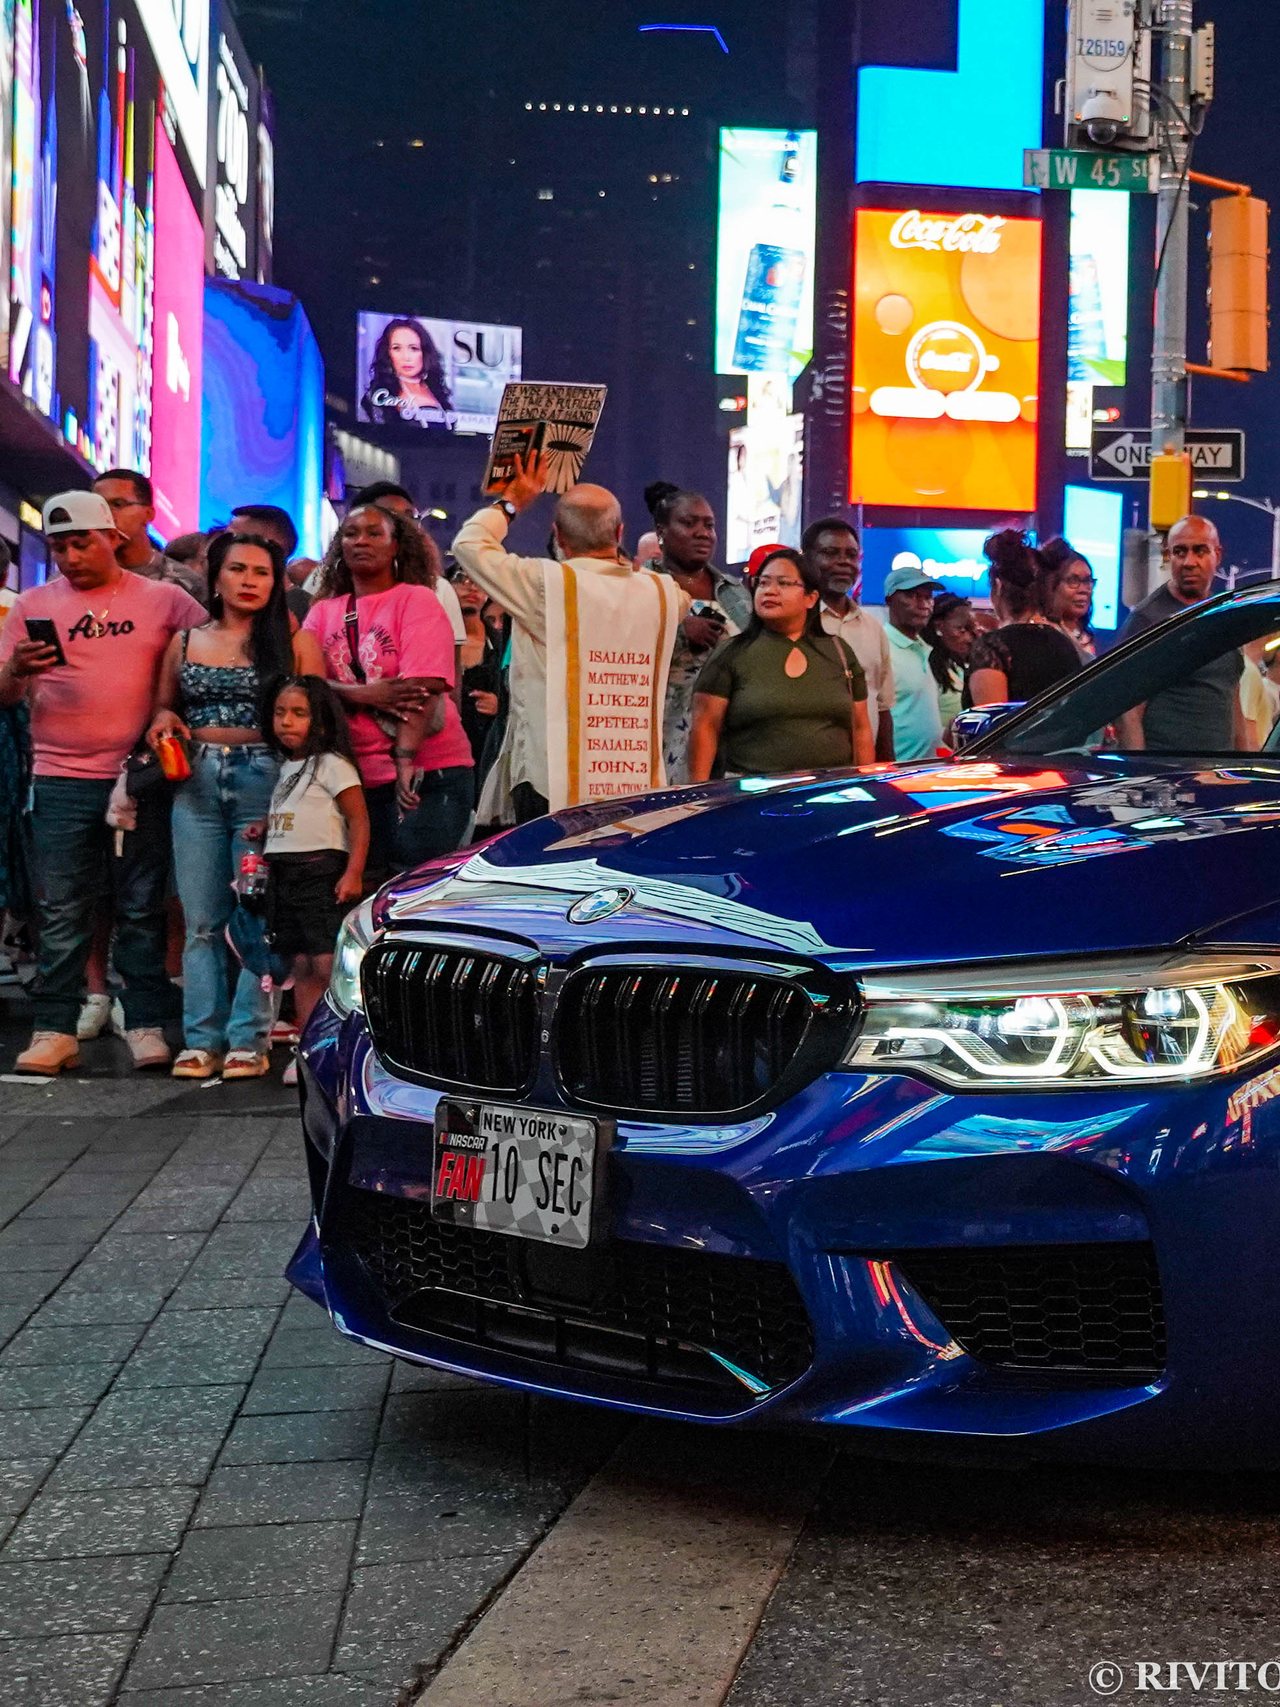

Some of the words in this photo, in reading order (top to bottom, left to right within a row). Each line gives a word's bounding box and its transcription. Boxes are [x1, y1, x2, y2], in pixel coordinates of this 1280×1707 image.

[1055, 157, 1078, 184] W
[1091, 159, 1121, 187] 45
[890, 210, 1006, 253] Coca-Cola
[454, 330, 504, 367] SU
[501, 408, 517, 420] THE
[504, 397, 520, 408] THE
[68, 614, 135, 642] Aero
[589, 650, 650, 665] ISAIAH.24
[588, 671, 650, 687] MATTHEW.24
[587, 716, 649, 730] 2PETER.3
[588, 738, 648, 752] ISAIAH.53
[483, 1111, 516, 1134] NEW
[520, 1118, 557, 1141] YORK
[450, 1132, 487, 1150] NASCAR
[435, 1151, 487, 1203] FAN
[491, 1143, 519, 1204] 10
[536, 1150, 583, 1216] SEC
